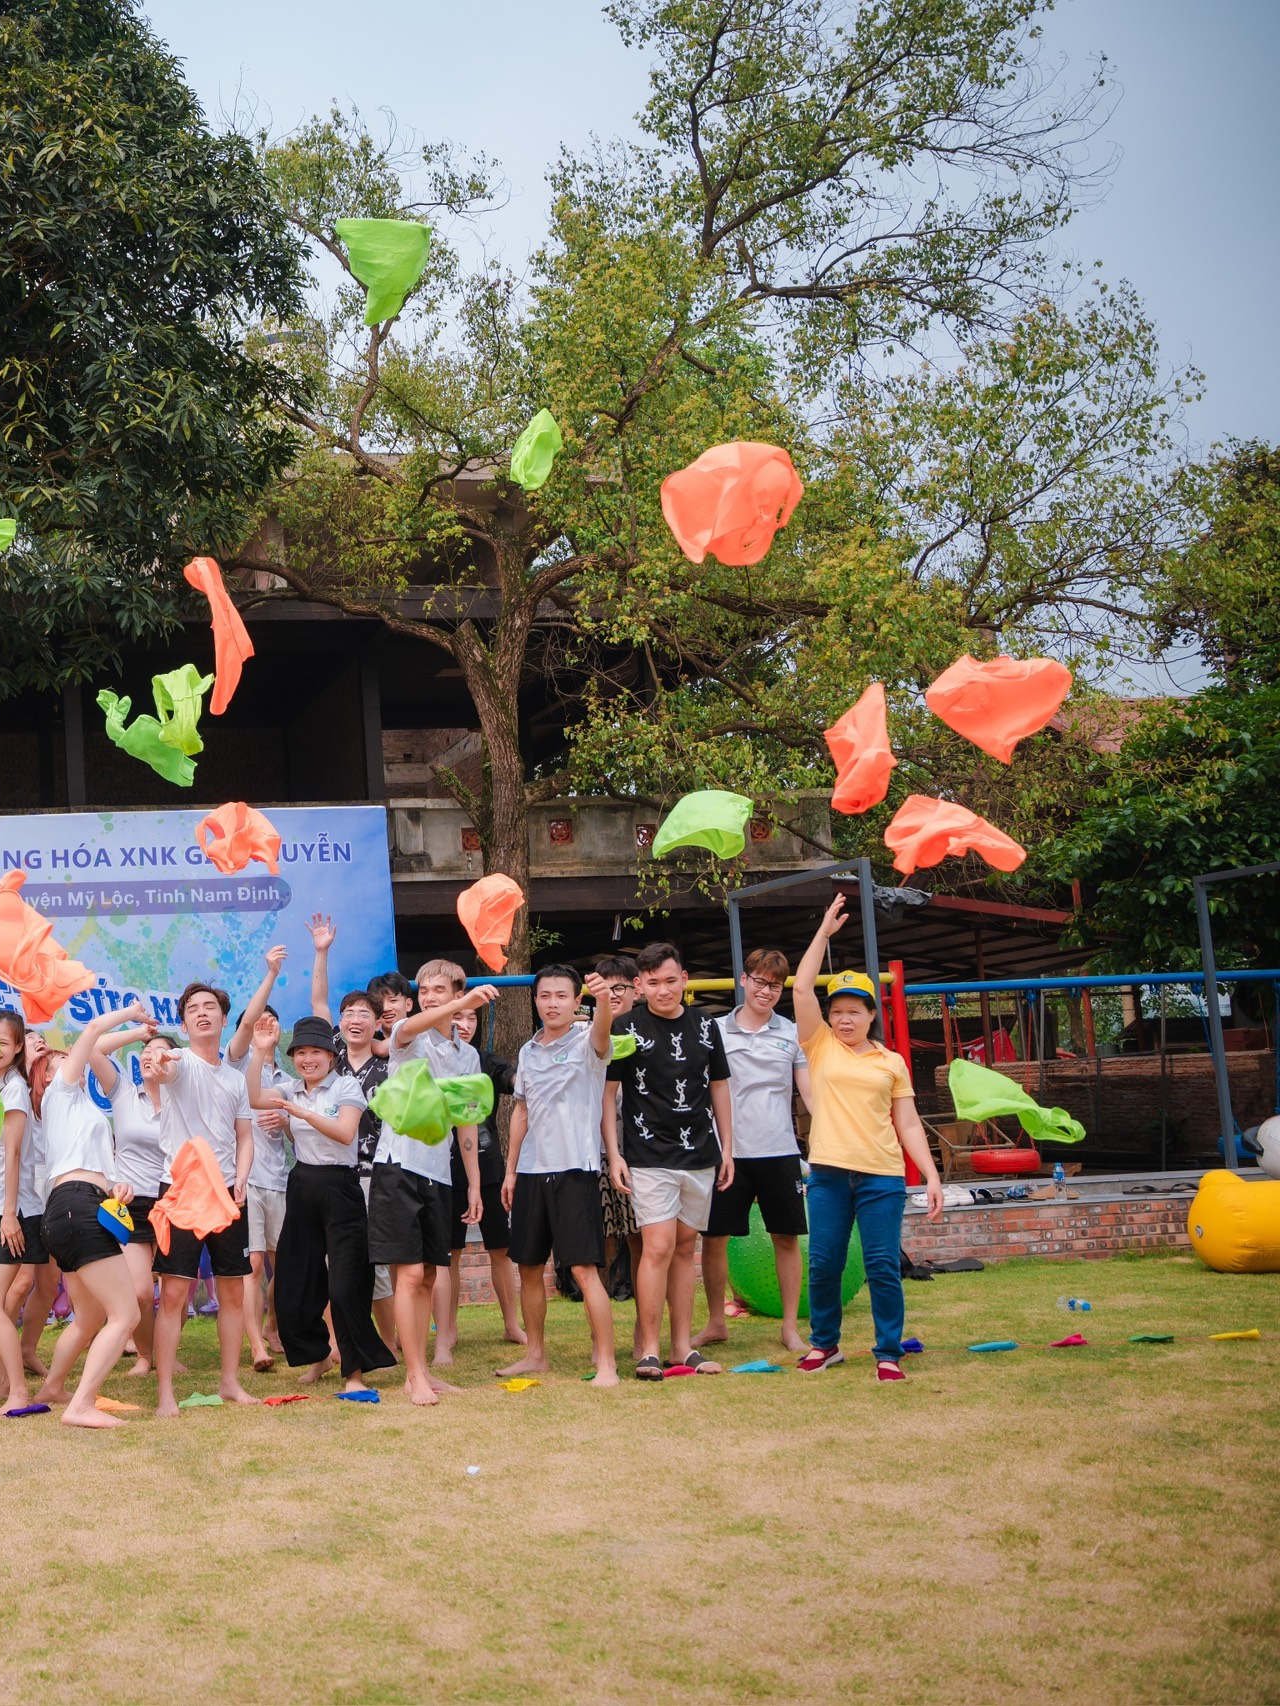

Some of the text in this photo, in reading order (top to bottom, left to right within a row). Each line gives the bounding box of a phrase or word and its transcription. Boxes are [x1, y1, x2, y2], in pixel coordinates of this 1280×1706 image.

[51, 843, 112, 869] HÓA
[119, 847, 178, 867] XNK
[254, 832, 352, 863] UYỄN
[25, 891, 62, 911] yện
[67, 890, 95, 910] Mỹ
[100, 889, 140, 908] Lộc,
[144, 887, 185, 905] Tỉnh
[190, 887, 232, 903] Nam
[236, 886, 280, 904] Định
